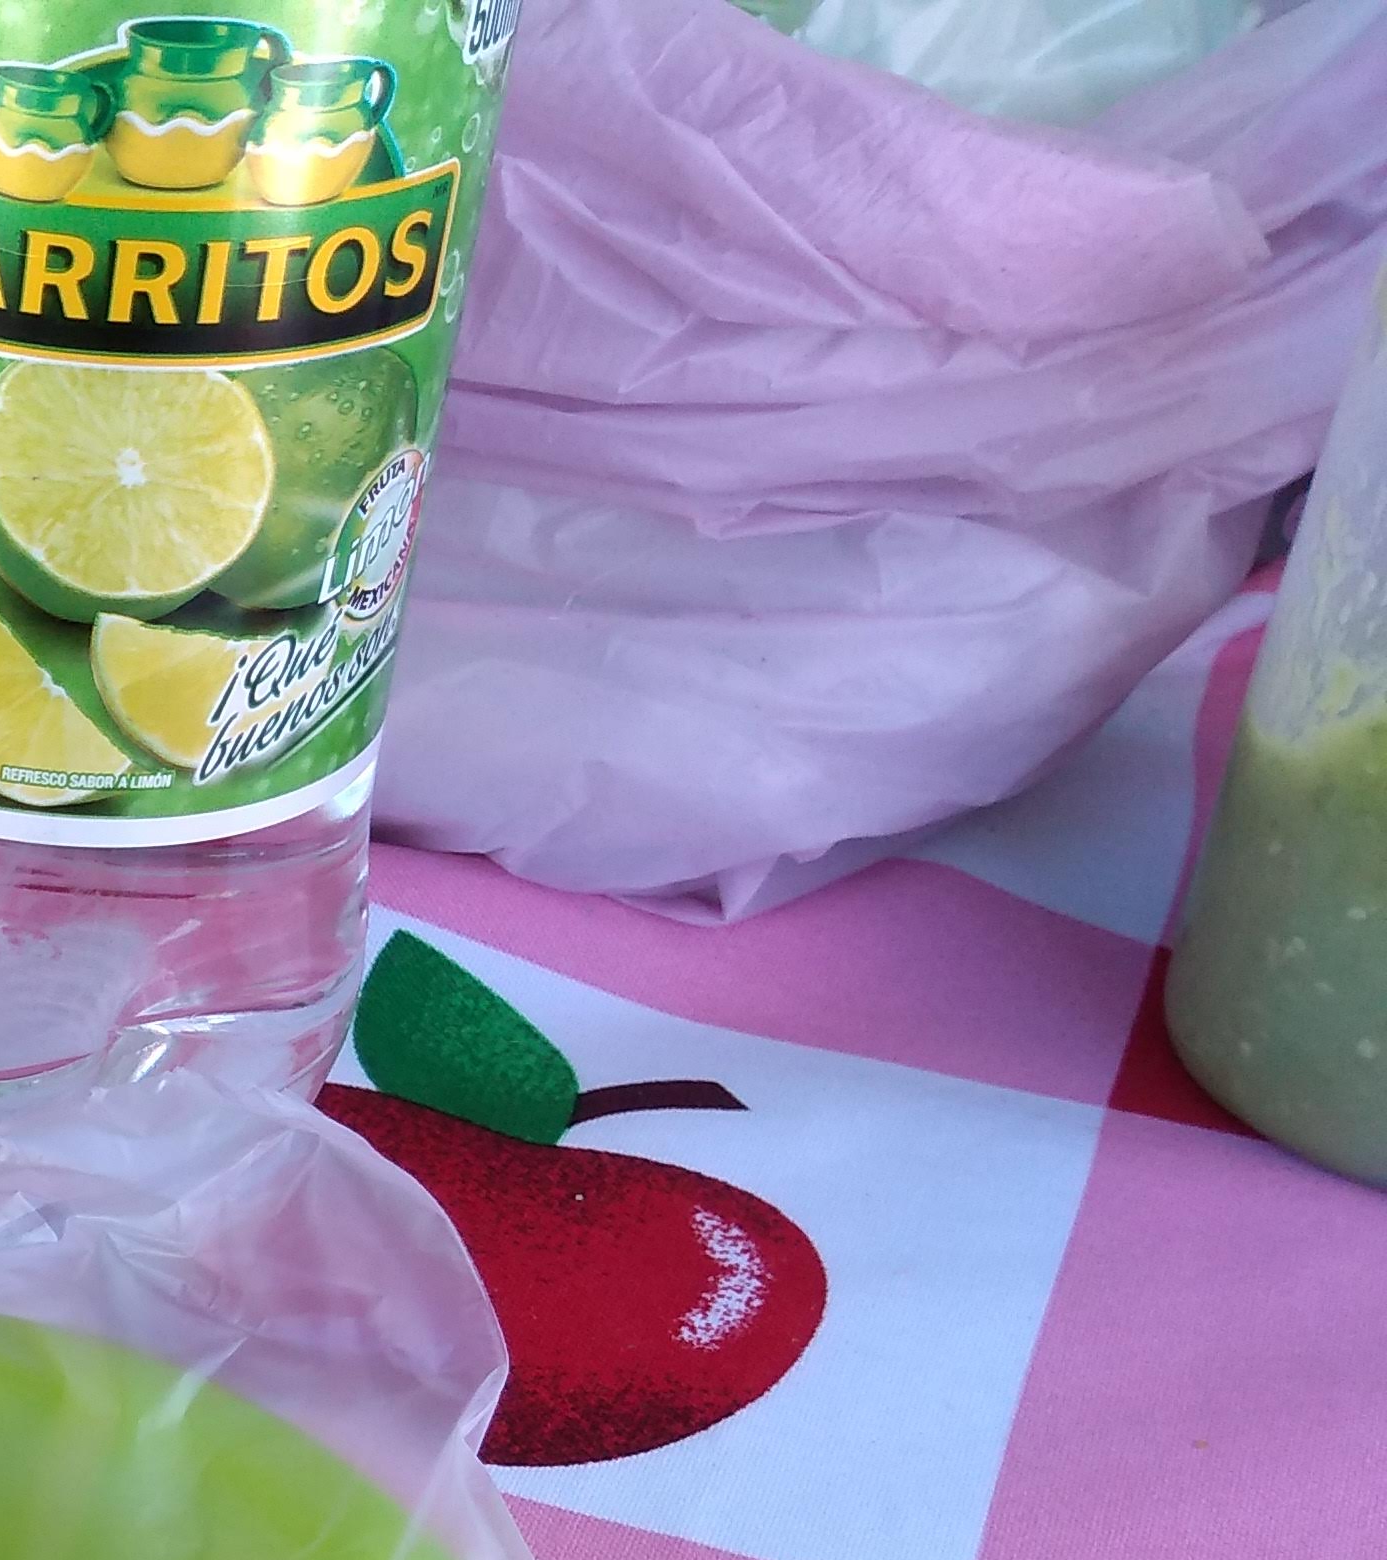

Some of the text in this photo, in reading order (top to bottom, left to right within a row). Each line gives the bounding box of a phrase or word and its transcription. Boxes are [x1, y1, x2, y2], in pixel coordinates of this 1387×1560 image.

[359, 457, 406, 515] FRUTA
[210, 608, 343, 723] ¡Qué
[199, 662, 347, 781] buenos
[1, 766, 173, 788] REFRESCO SABOR A LIMÓN
